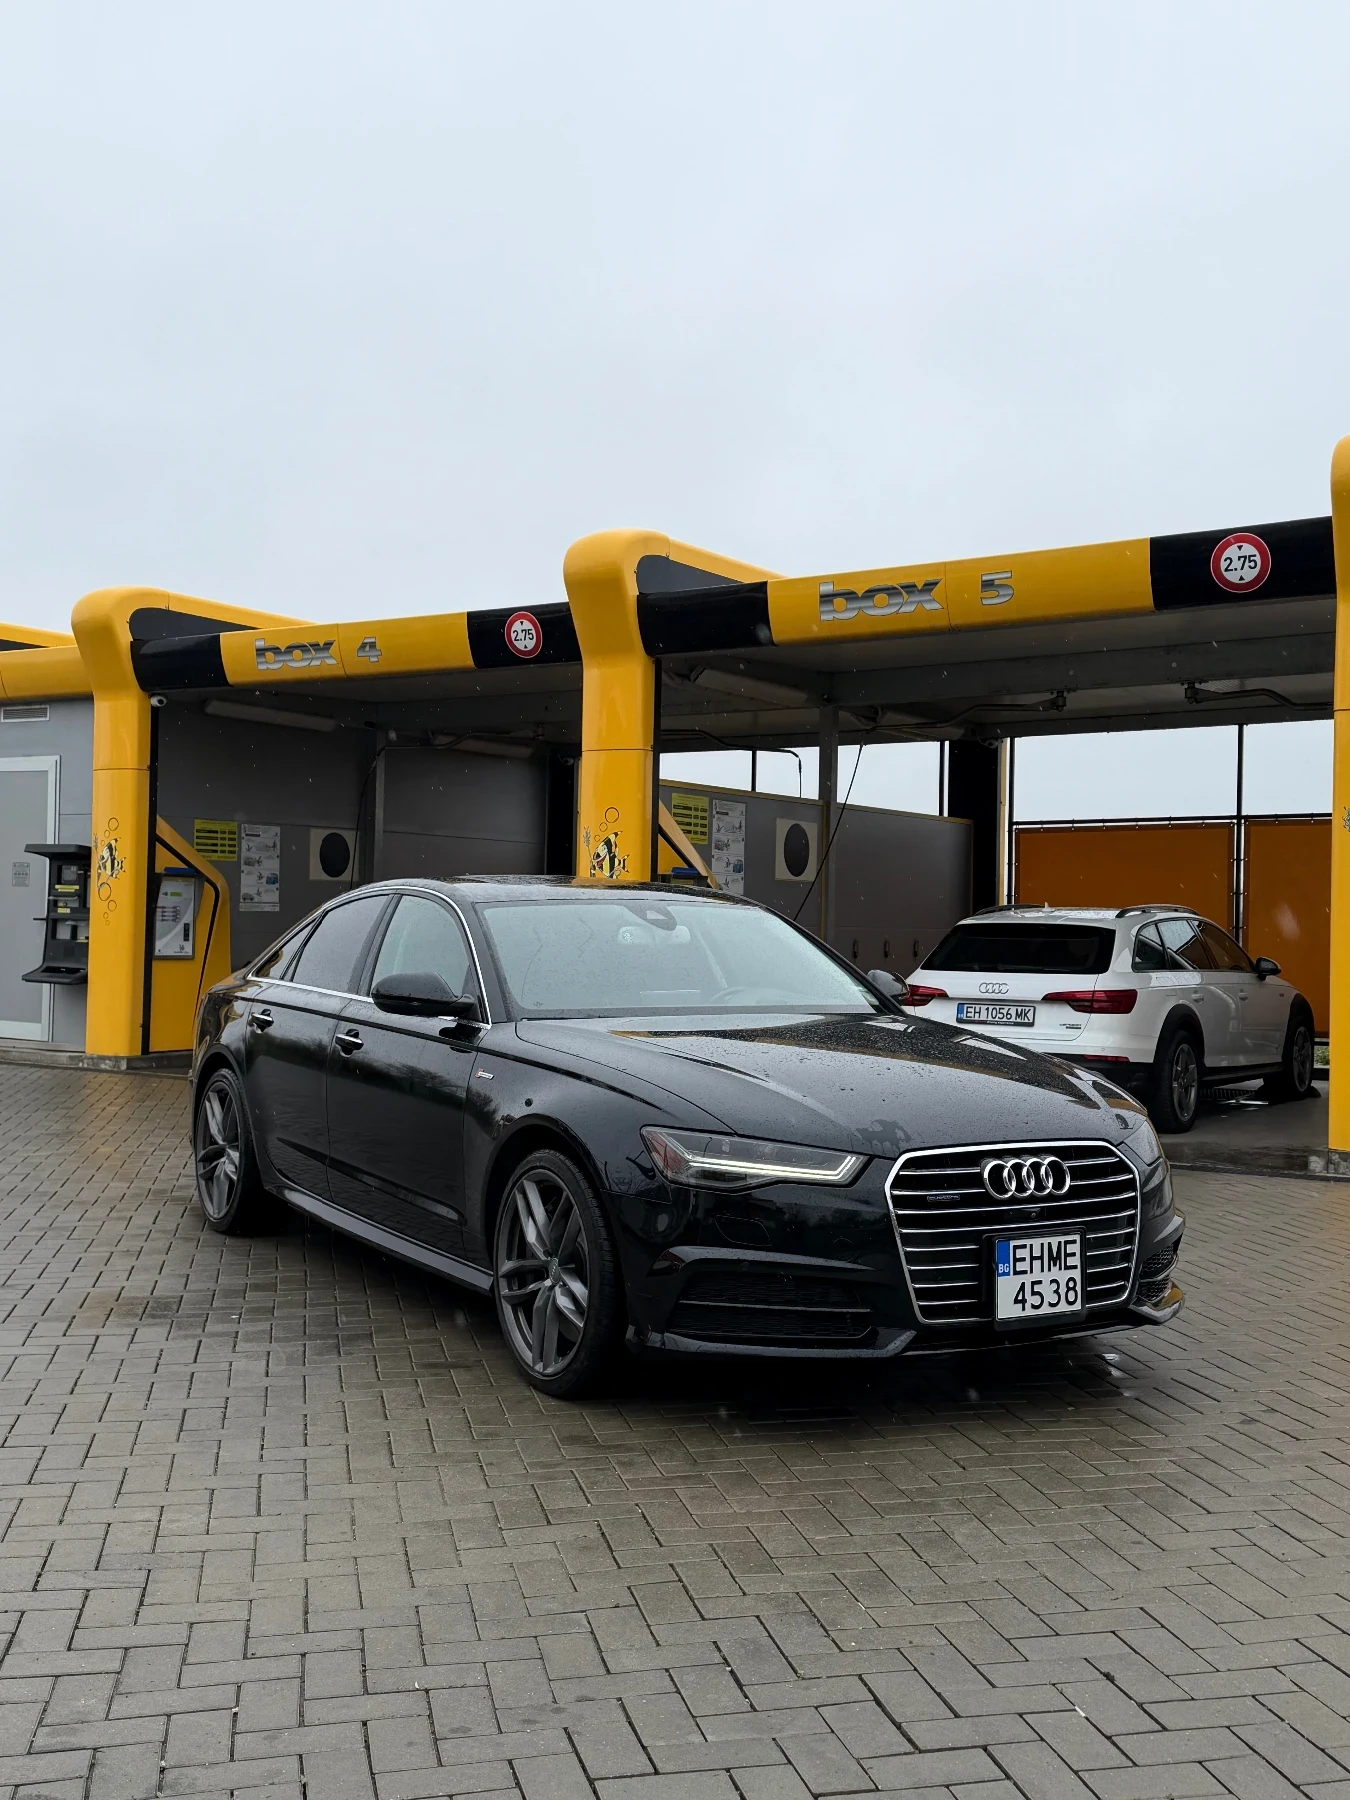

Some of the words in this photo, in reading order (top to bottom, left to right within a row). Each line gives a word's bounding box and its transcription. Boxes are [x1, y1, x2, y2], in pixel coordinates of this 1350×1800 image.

[1223, 553, 1258, 573] 2.75
[819, 577, 944, 622] box
[980, 569, 1014, 606] 5
[512, 627, 534, 642] 2.75
[255, 638, 337, 670] box
[356, 636, 382, 663] 4
[965, 1006, 981, 1018] EH
[985, 1006, 1012, 1020] 1056
[1015, 1008, 1031, 1022] MK
[998, 1264, 1009, 1273] BG
[1012, 1239, 1078, 1276] EHME
[1013, 1276, 1079, 1312] 4538
